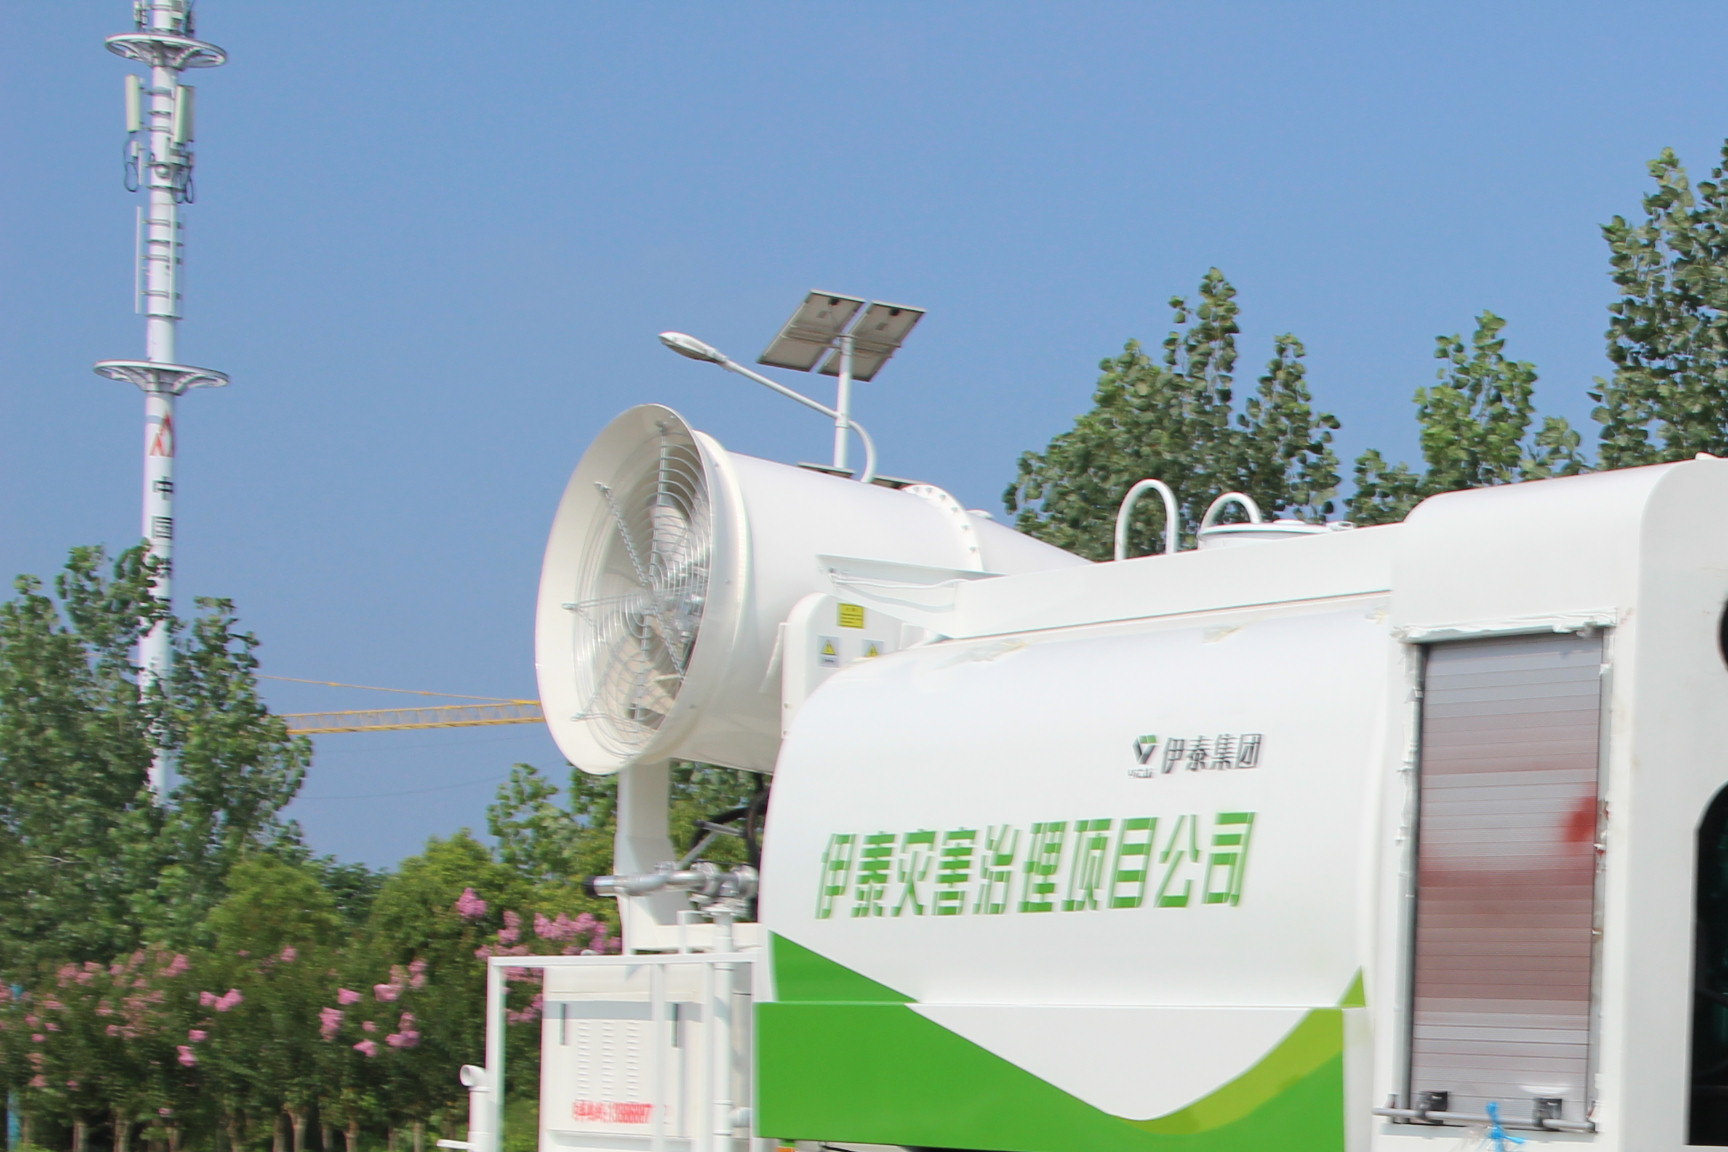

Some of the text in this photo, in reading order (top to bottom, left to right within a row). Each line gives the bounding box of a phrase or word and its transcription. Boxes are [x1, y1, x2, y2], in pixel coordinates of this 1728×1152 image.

[1161, 733, 1264, 775] 伊泰集团
[815, 811, 1257, 919] 伊泰灾害治理项目公司
